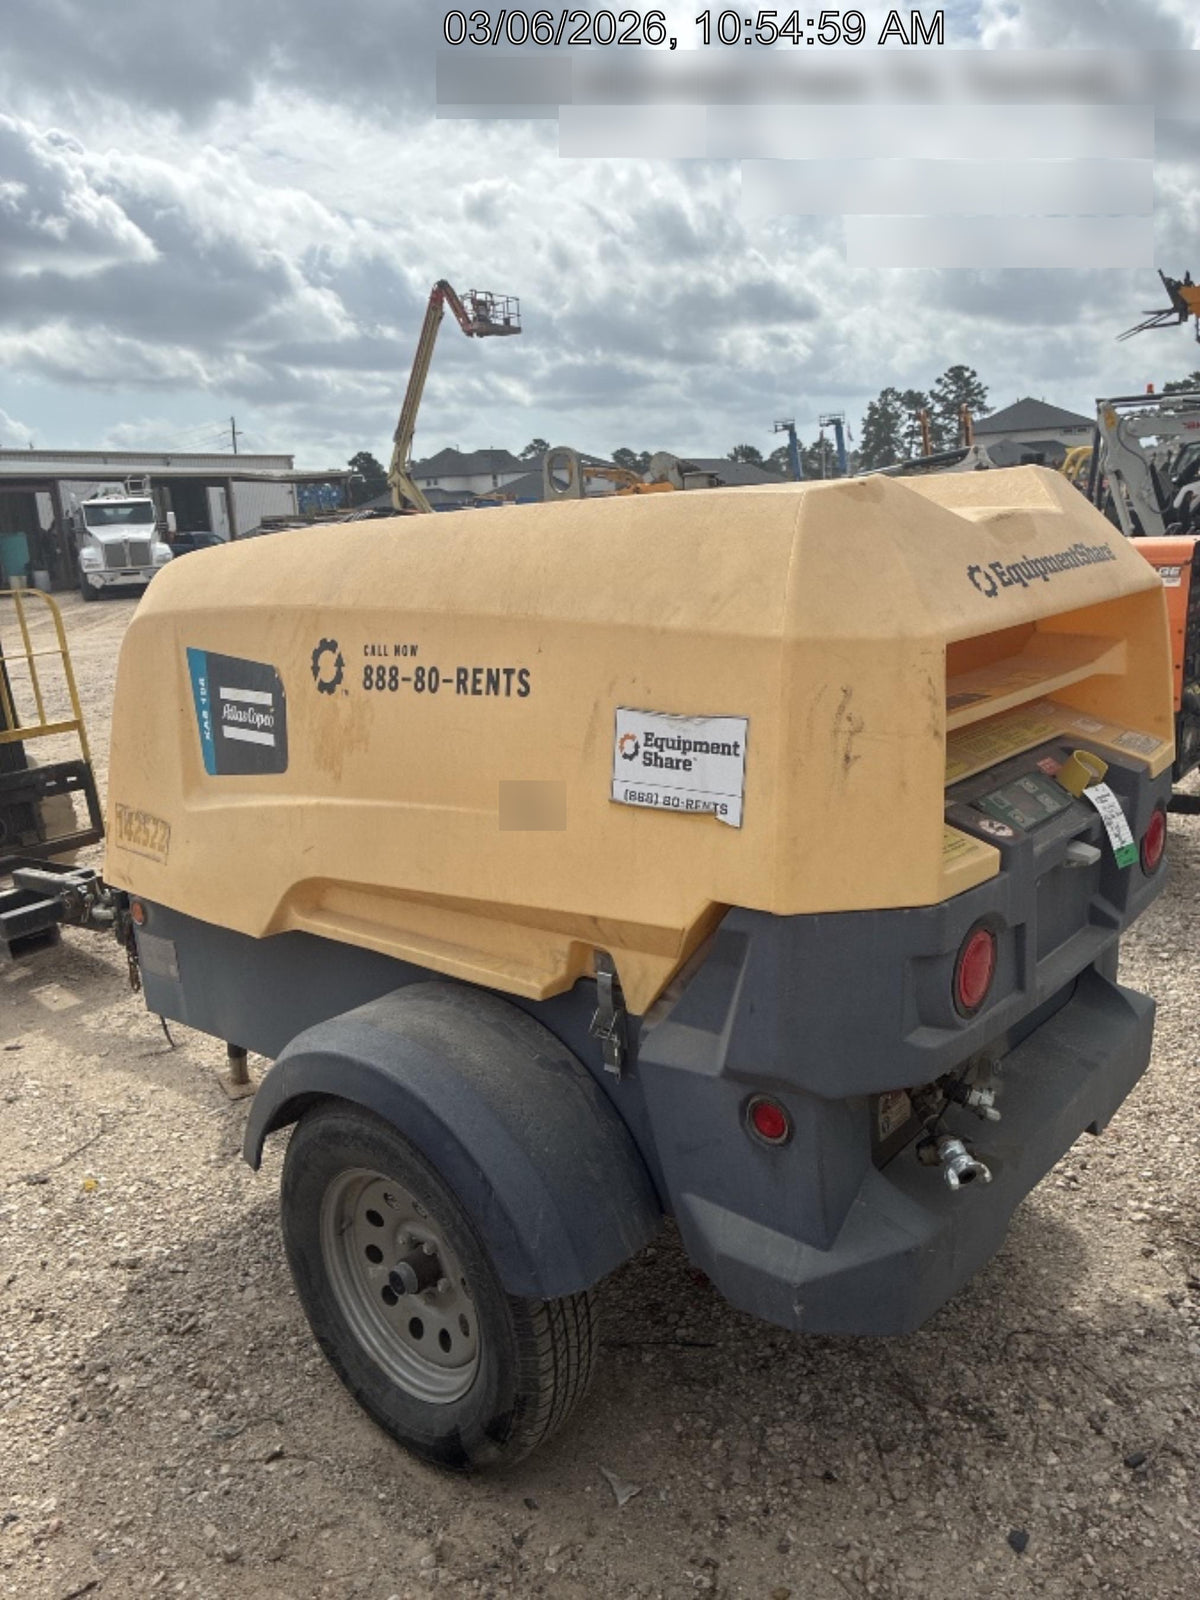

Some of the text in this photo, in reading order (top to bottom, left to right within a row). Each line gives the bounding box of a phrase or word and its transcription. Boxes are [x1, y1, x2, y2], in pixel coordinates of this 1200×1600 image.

[989, 543, 1117, 588] EquipmentShare
[363, 644, 419, 657] CALL NOW
[362, 664, 531, 698] 888-80-RENTS
[643, 731, 740, 757] Equipment
[642, 751, 693, 772] Share
